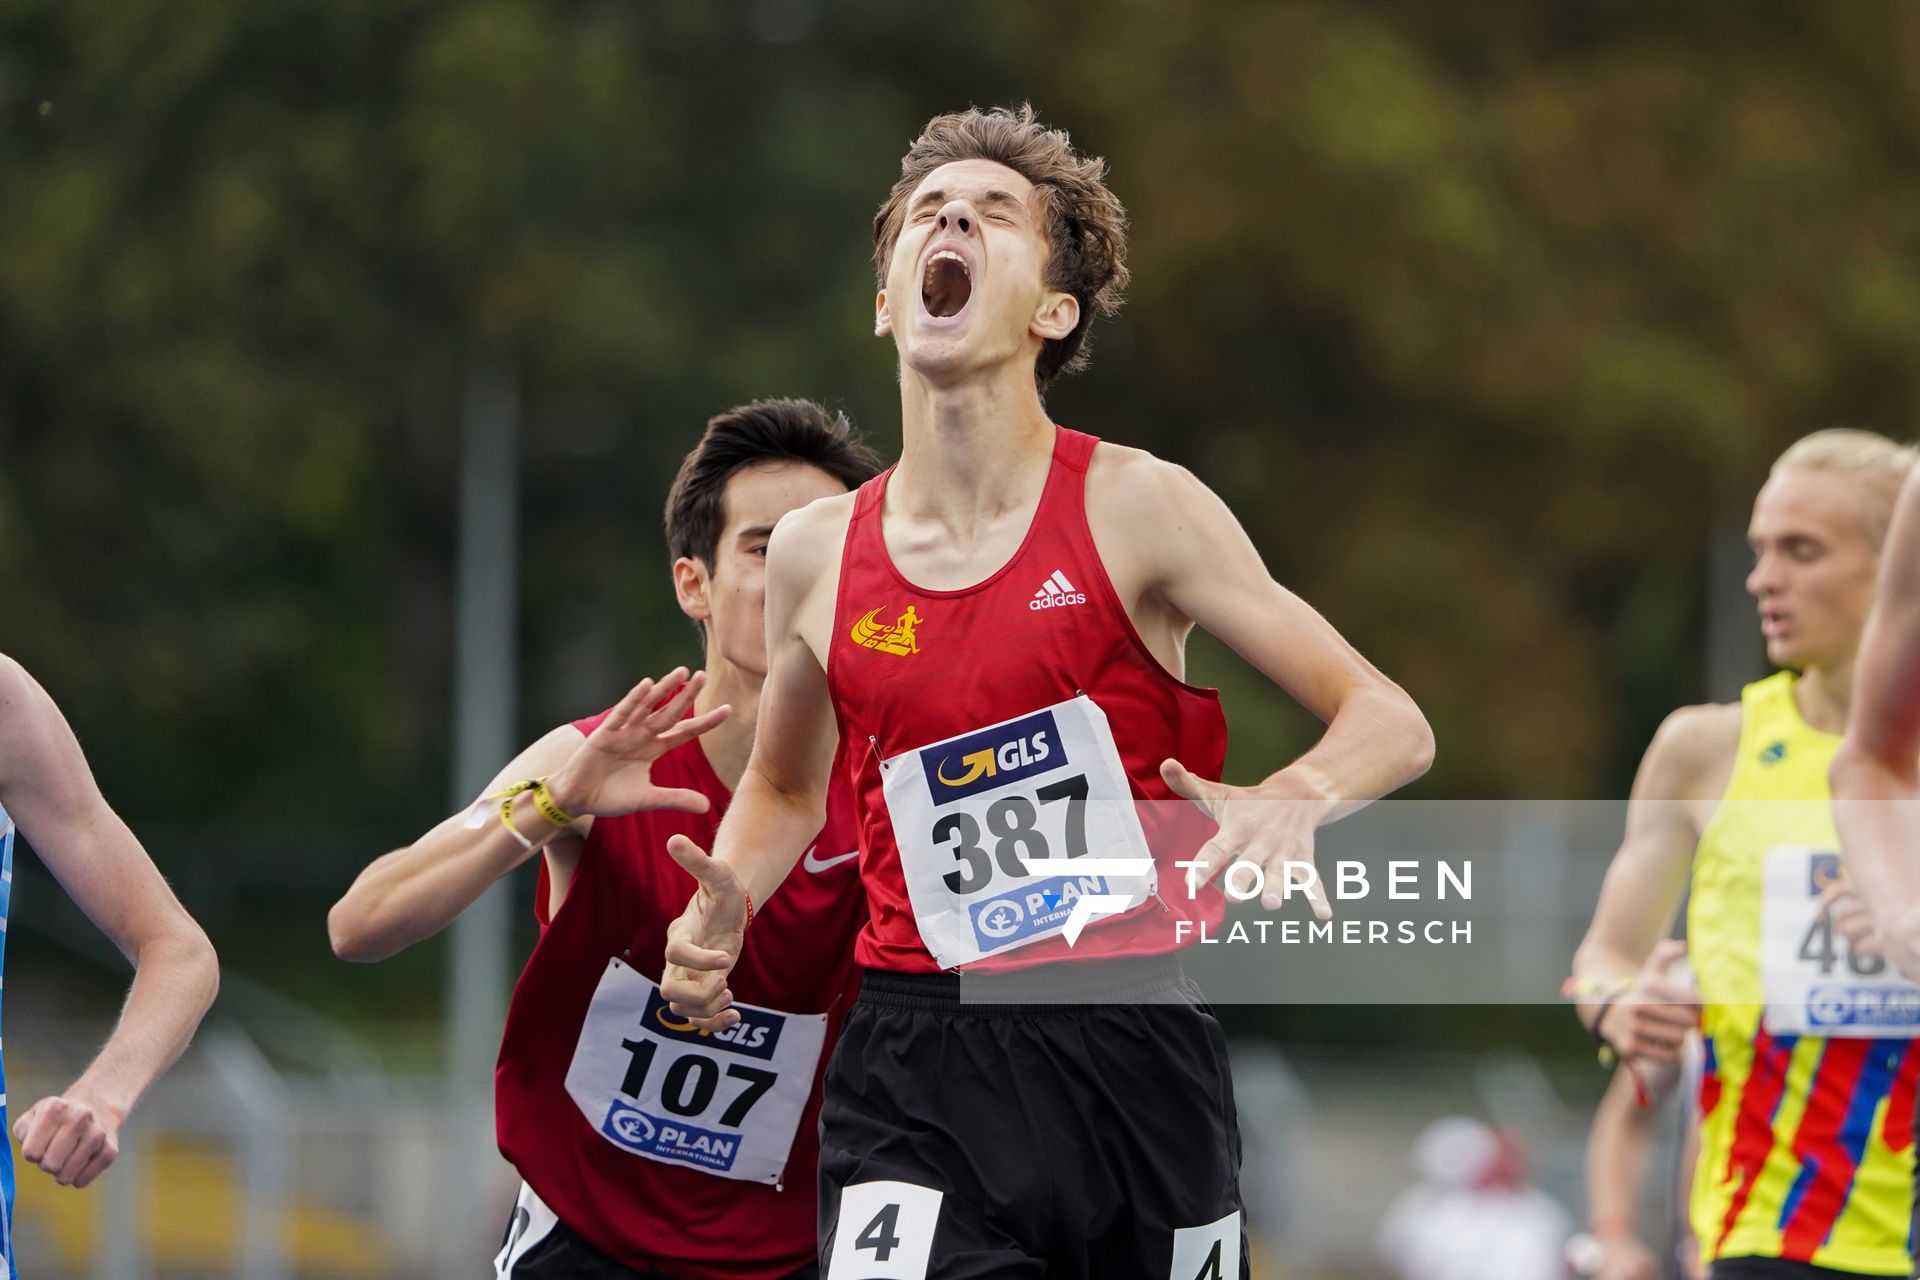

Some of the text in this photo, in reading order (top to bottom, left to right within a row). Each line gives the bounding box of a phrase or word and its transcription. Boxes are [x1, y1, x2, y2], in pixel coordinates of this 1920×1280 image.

[1029, 592, 1086, 610] adidas
[997, 731, 1049, 771] GLS
[932, 773, 1089, 895] 387
[620, 1037, 778, 1128] 107
[655, 1144, 726, 1167] INTERNATIONAL
[658, 1126, 734, 1158] PLAN
[855, 1203, 900, 1262] 4
